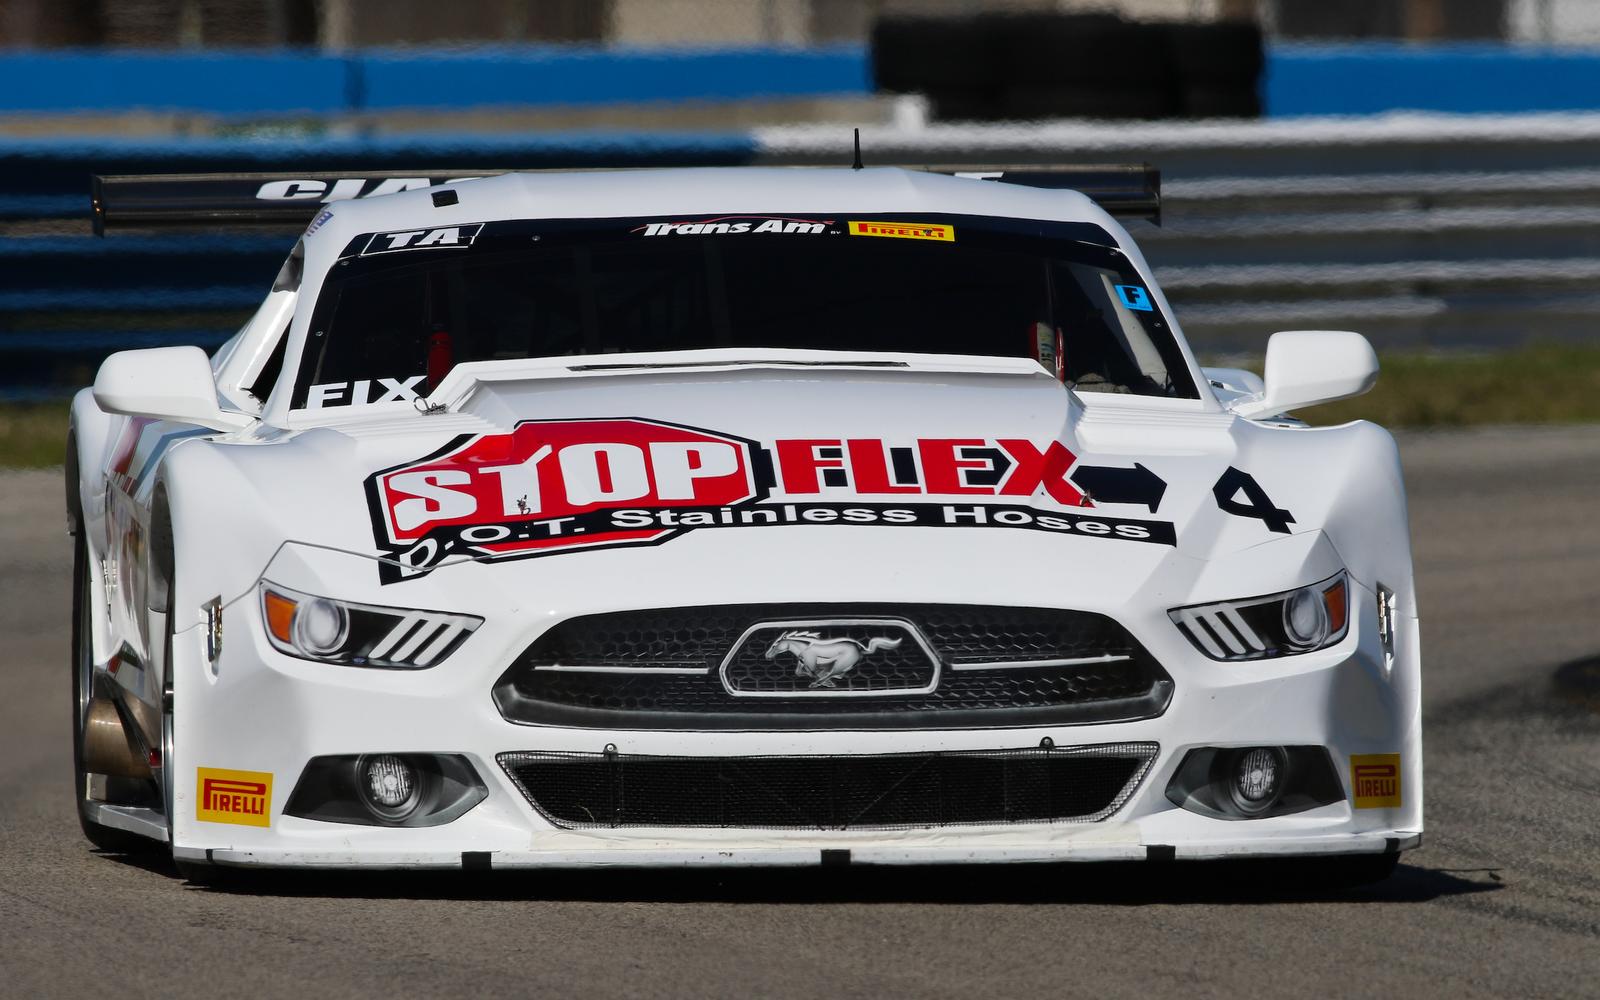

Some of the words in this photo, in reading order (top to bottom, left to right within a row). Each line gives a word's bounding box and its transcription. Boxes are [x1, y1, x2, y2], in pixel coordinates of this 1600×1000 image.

[385, 227, 459, 249] TA
[644, 222, 752, 237] Trans
[752, 219, 826, 235] Am
[858, 223, 945, 238] PIRELLI
[1122, 287, 1140, 304] F
[306, 375, 427, 410] FIX
[389, 441, 739, 531] STOP
[776, 439, 1096, 508] FLEX
[1212, 465, 1297, 535] 4
[610, 504, 918, 528] Stainless
[942, 506, 1151, 538] Hoses
[203, 778, 266, 815] PIRELLI
[1354, 765, 1396, 797] PIRELLI
